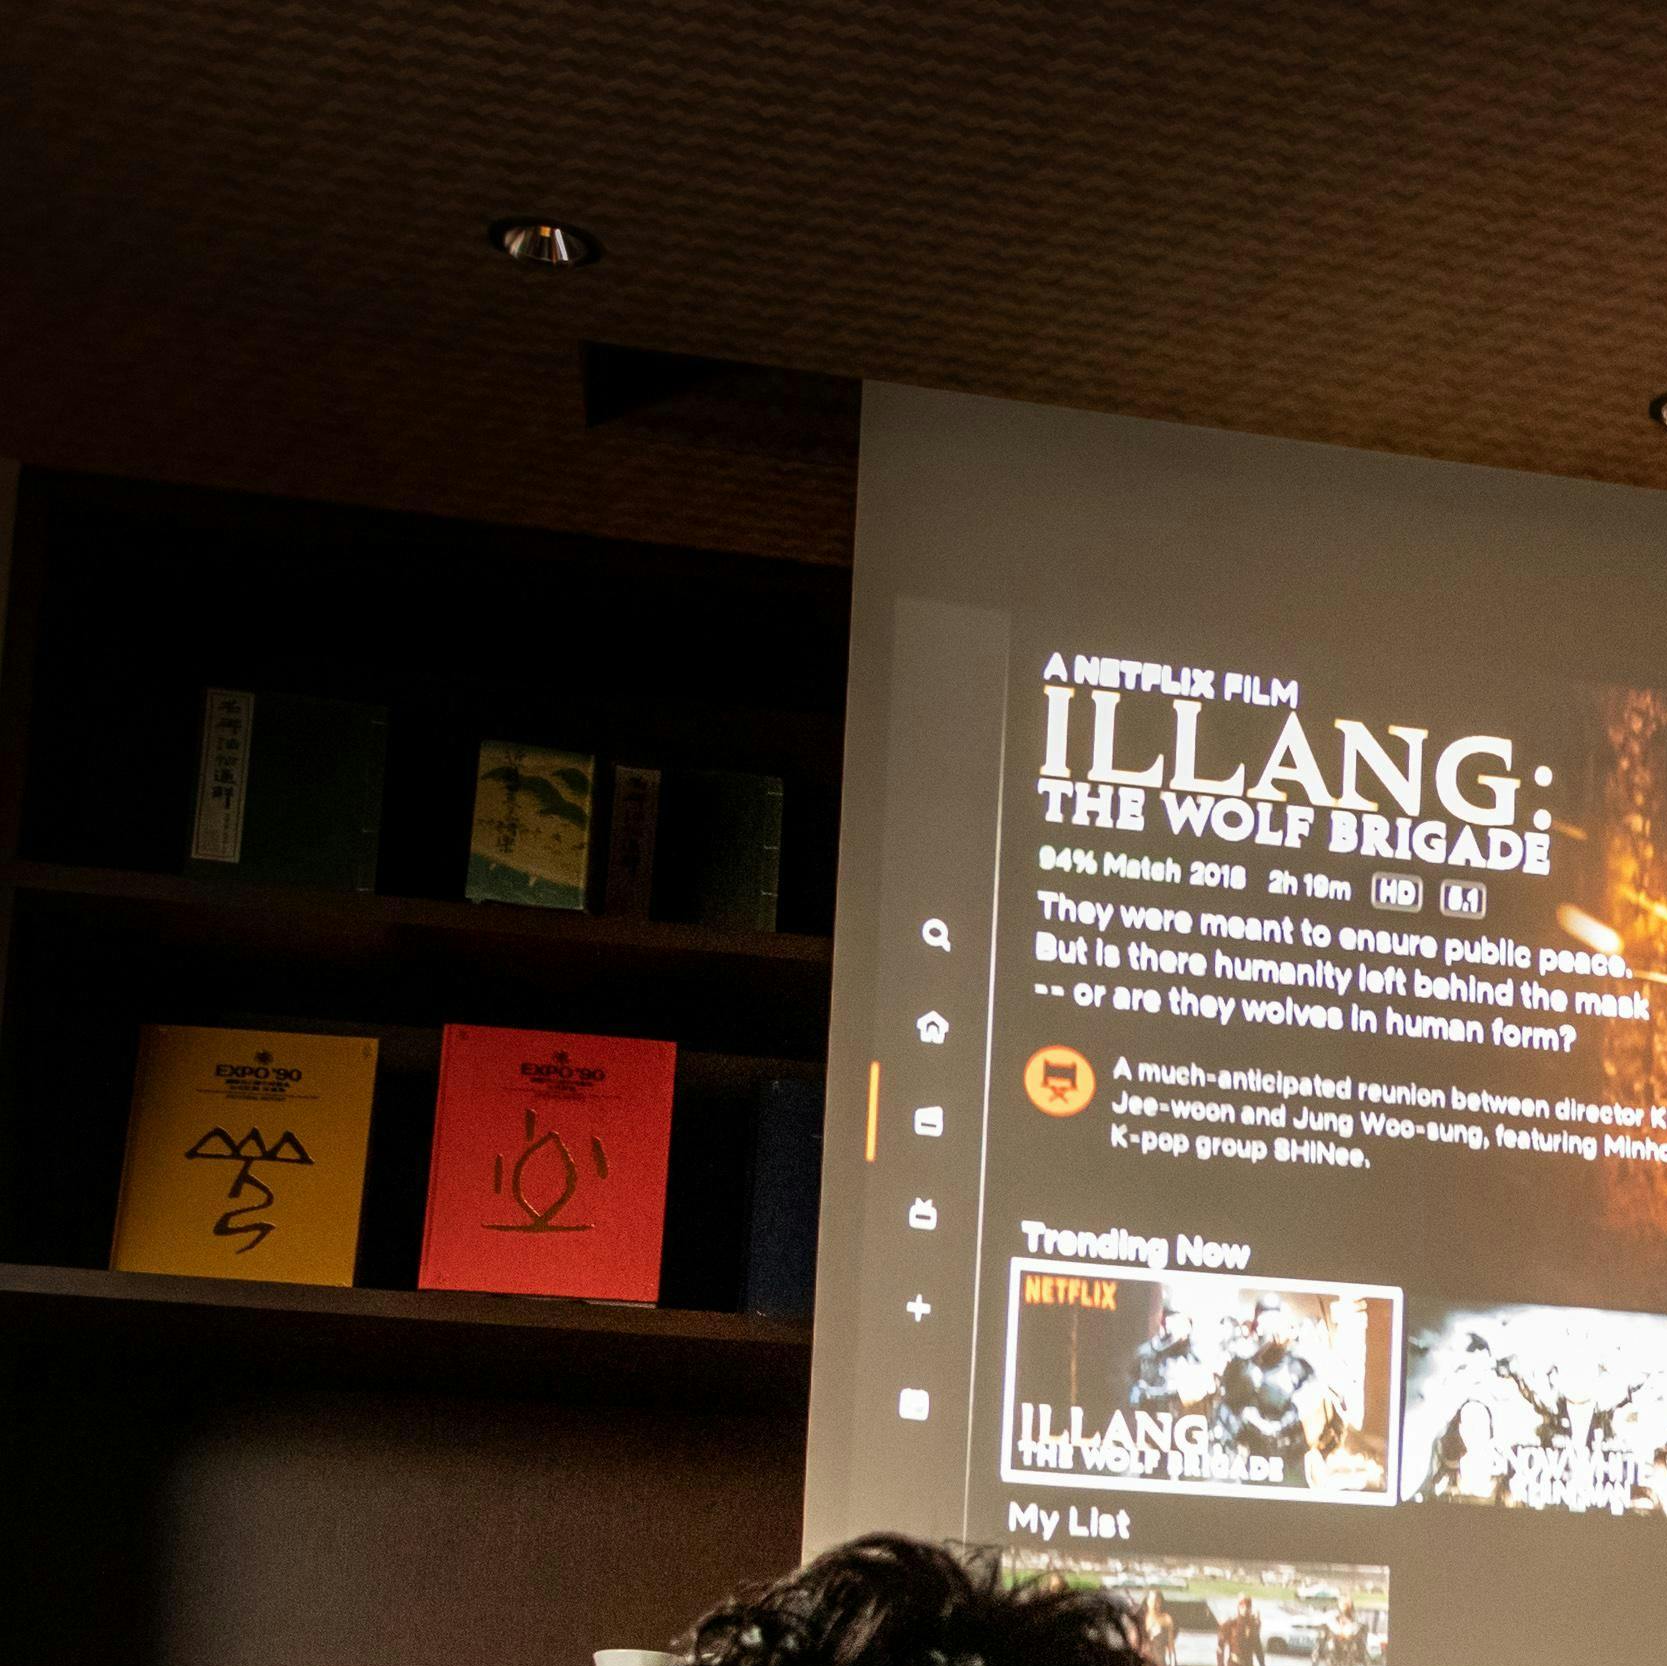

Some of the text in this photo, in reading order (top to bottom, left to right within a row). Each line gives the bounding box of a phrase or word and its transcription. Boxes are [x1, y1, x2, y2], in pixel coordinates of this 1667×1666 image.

[1043, 652, 1300, 709] A NETFLIX FILM
[1039, 684, 1553, 832] ILLANG:
[1037, 777, 1552, 877] THE WOLF BRIGADE
[1102, 851, 1182, 884] Match
[1189, 860, 1247, 891] 2018
[1267, 869, 1298, 898] 2h
[1378, 878, 1416, 907] HD
[1036, 889, 1634, 980] They were meant to ensure public peace.
[1035, 931, 1650, 1021] But is there humanity left behind the mask
[1072, 982, 1107, 1007] or
[1112, 986, 1162, 1014] are
[1167, 986, 1236, 1026] they
[1241, 997, 1344, 1031] wolves
[1351, 1005, 1378, 1034] in
[1386, 1006, 1485, 1045] human
[1491, 1017, 1577, 1052] form?
[214, 1063, 270, 1079] EXPO
[520, 1062, 574, 1079] EXPO
[1112, 1056, 1132, 1081] A
[1137, 1061, 1352, 1100] much-anticipated
[1358, 1080, 1446, 1108] reunion
[1450, 1085, 1550, 1119] between
[1555, 1097, 1645, 1127] director
[1110, 1123, 1371, 1169] K-pop group SHINee.
[1111, 1090, 1235, 1123] Jee-woon
[1240, 1103, 1286, 1128] and
[1292, 1106, 1354, 1138] Jung
[1360, 1110, 1490, 1150] Woo-sung,
[1495, 1123, 1597, 1161] featuring
[1020, 1219, 1252, 1270] Trending Now
[1024, 1274, 1118, 1311] NETFLIX
[1018, 1439, 1285, 1484] THE WOLF BRIGADE
[1008, 1501, 1131, 1541] My List
